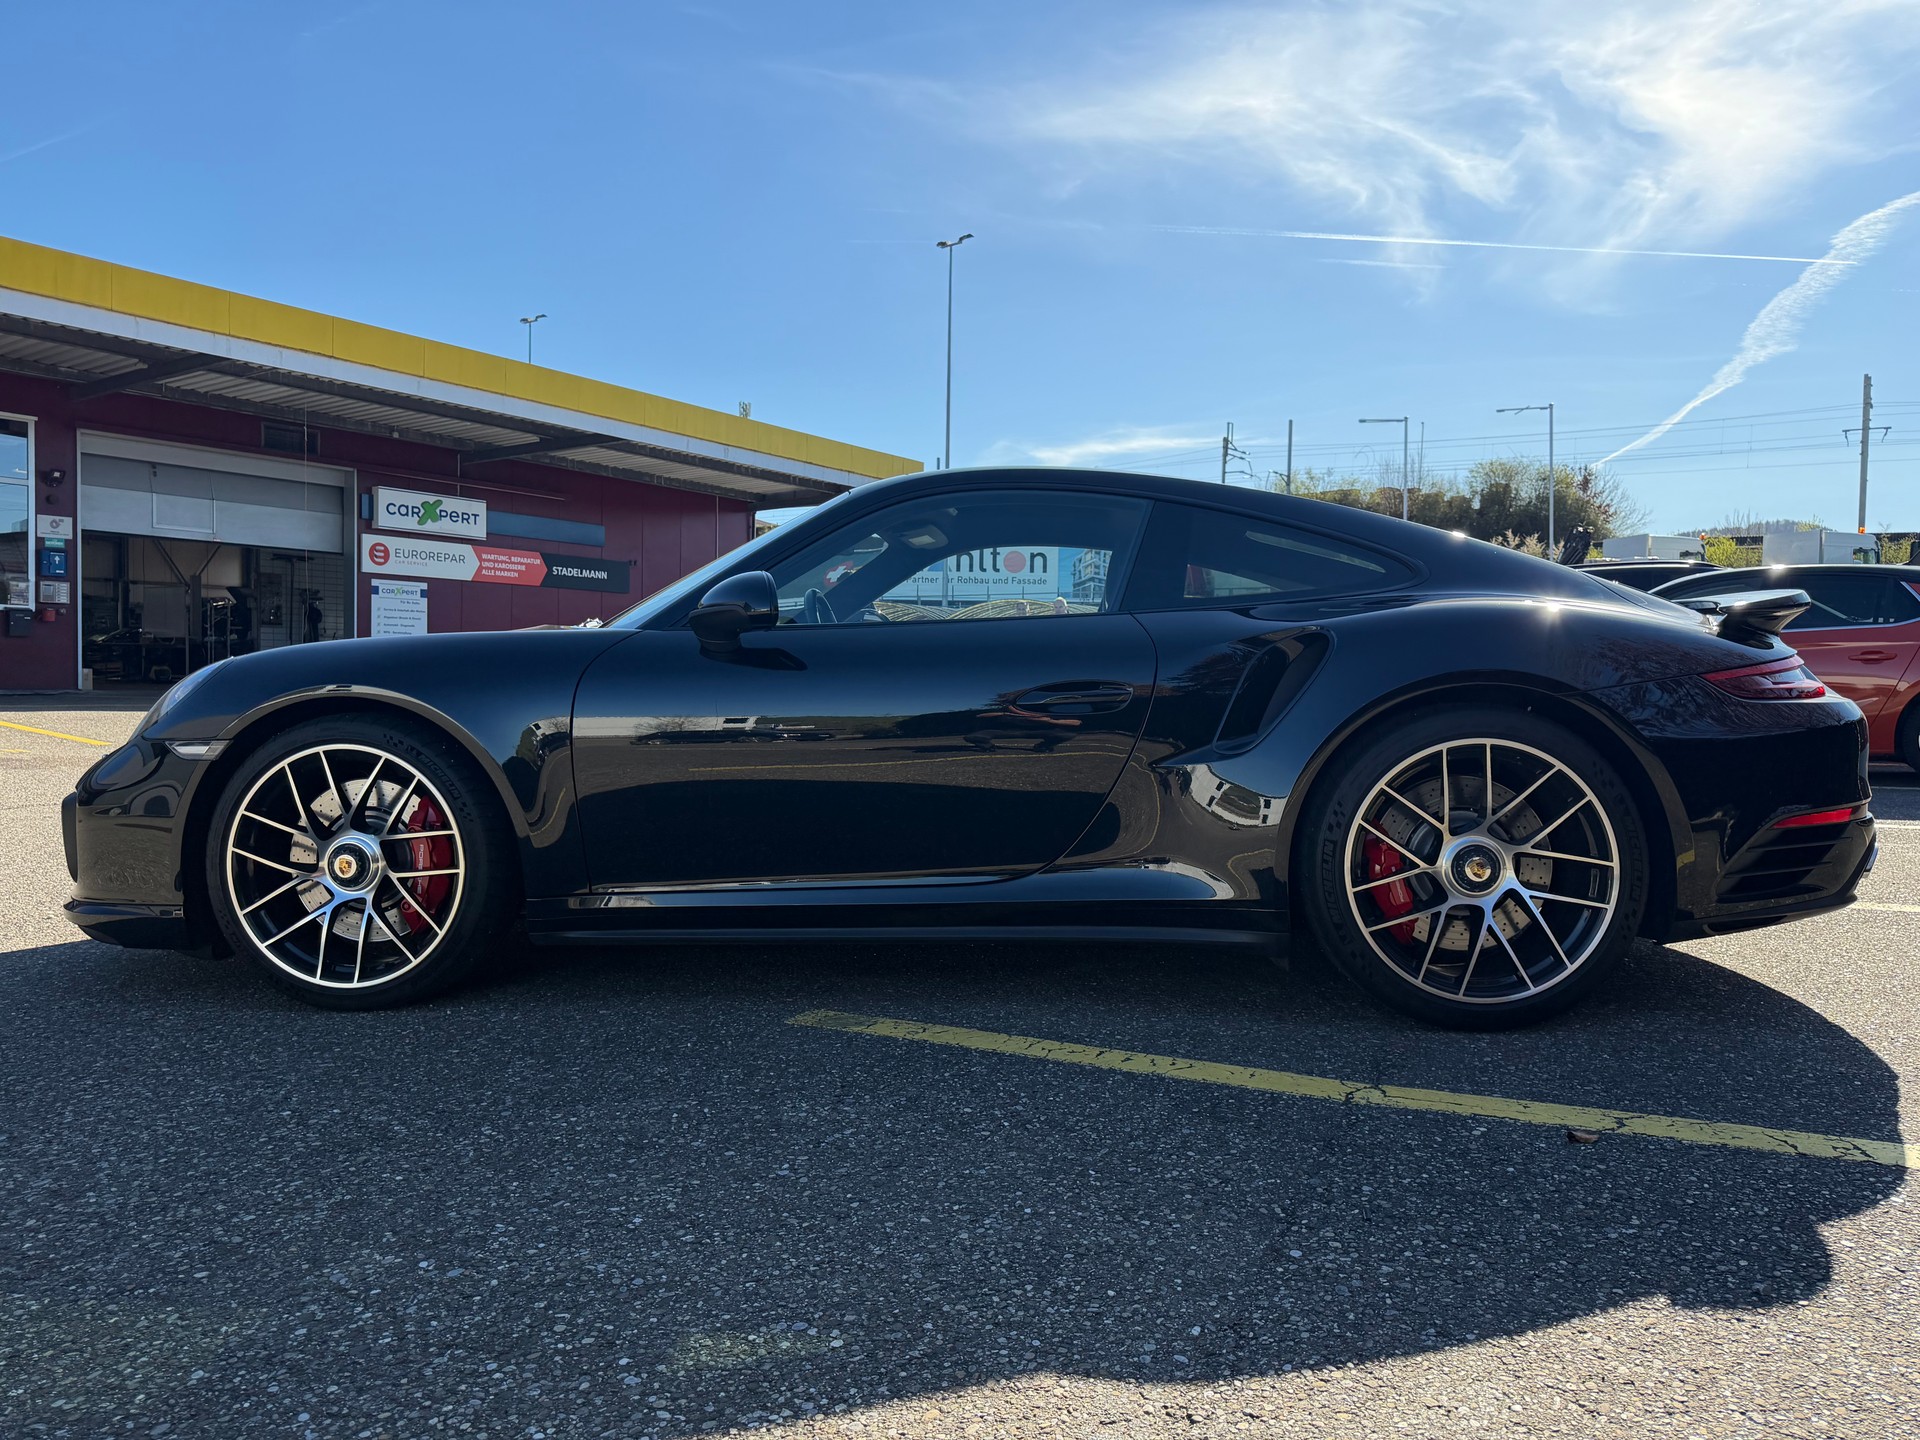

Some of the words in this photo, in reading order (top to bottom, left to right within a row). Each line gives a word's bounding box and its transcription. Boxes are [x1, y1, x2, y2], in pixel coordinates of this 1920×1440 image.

[394, 548, 466, 564] EUROREPAR
[481, 553, 511, 562] WARTUNG,
[511, 556, 541, 565] REPARATUR
[495, 562, 526, 571] KAROSSERIE
[495, 570, 519, 578] MARKEN
[552, 566, 608, 580] STADELMANN
[906, 576, 940, 584] artner
[957, 576, 990, 584] Rohbau
[993, 577, 1009, 585] und
[1012, 577, 1048, 585] Fassade
[419, 753, 462, 801] MICHELIN
[1321, 838, 1343, 924] MICHELIN
